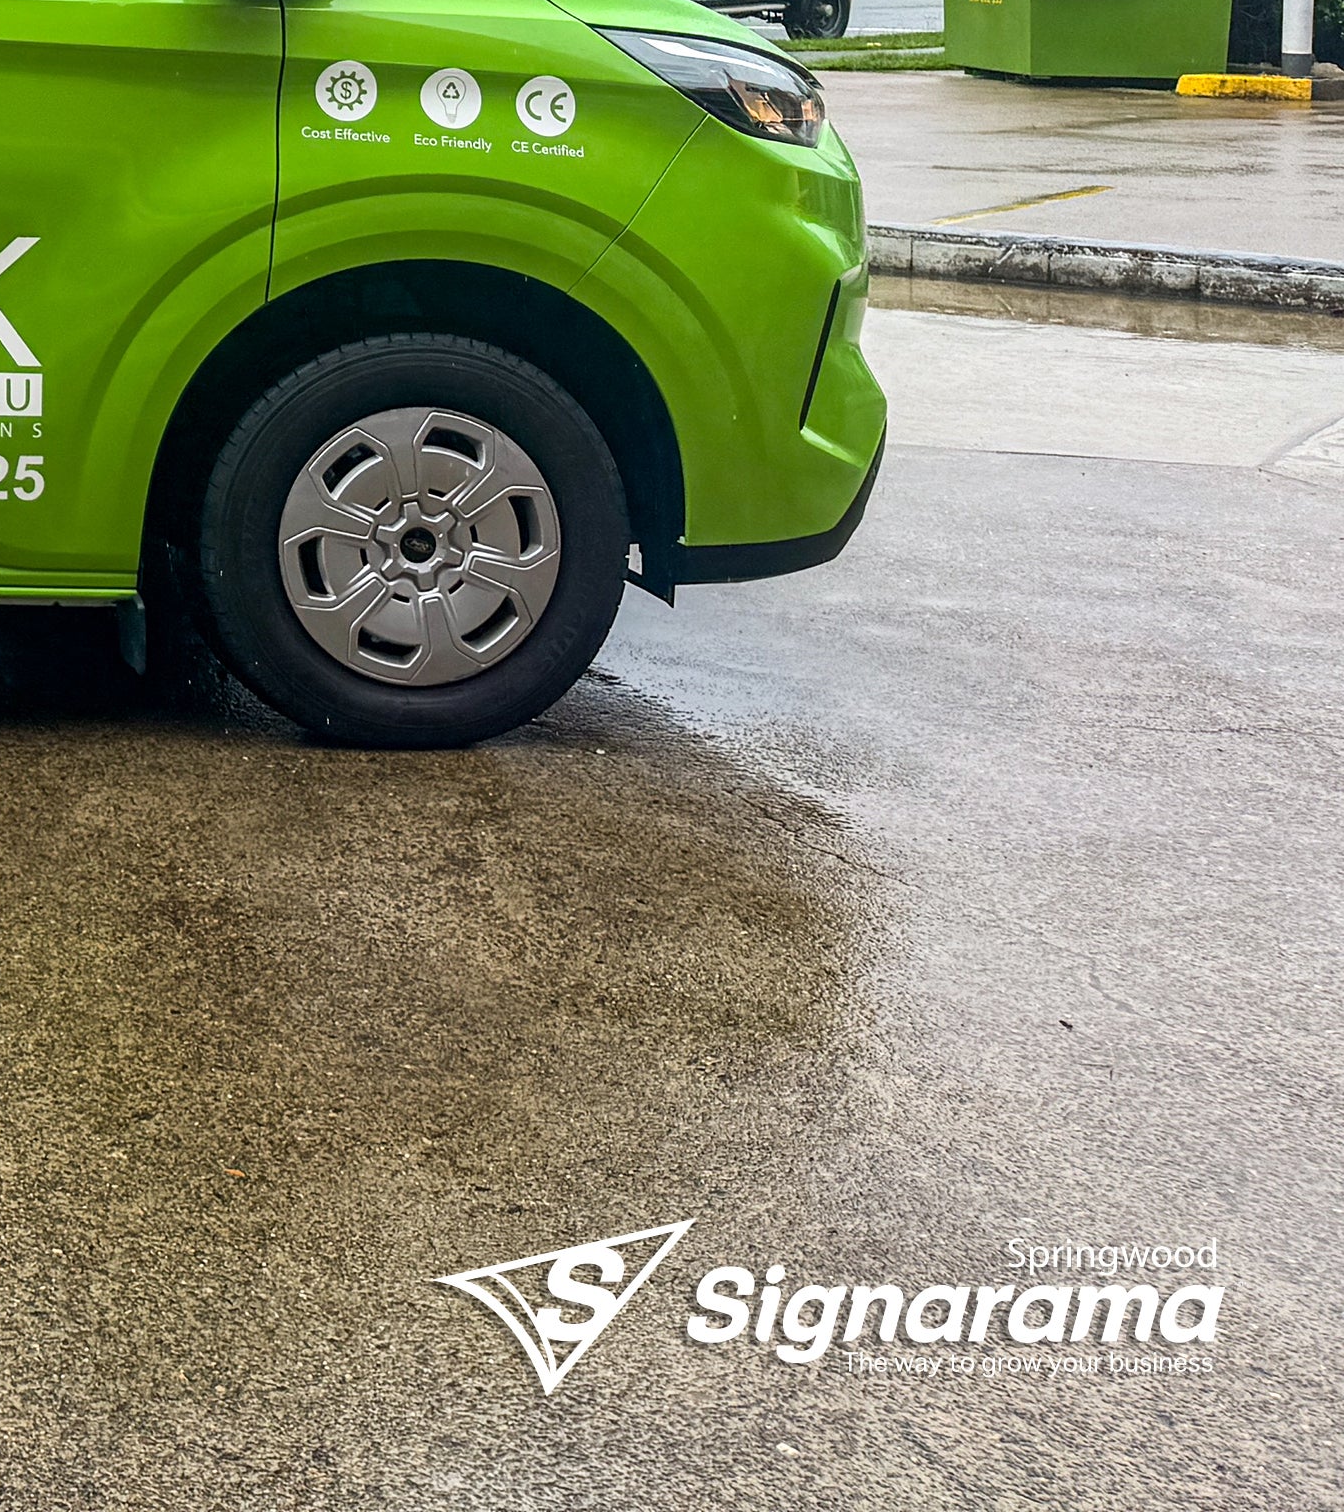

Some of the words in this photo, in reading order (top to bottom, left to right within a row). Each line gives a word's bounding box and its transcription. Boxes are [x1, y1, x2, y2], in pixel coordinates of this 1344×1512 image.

[301, 126, 332, 140] Cost
[334, 128, 391, 144] Effective
[414, 134, 438, 147] Eco
[441, 135, 493, 153] Friendly
[511, 140, 530, 154] CE
[532, 142, 585, 158] Certified
